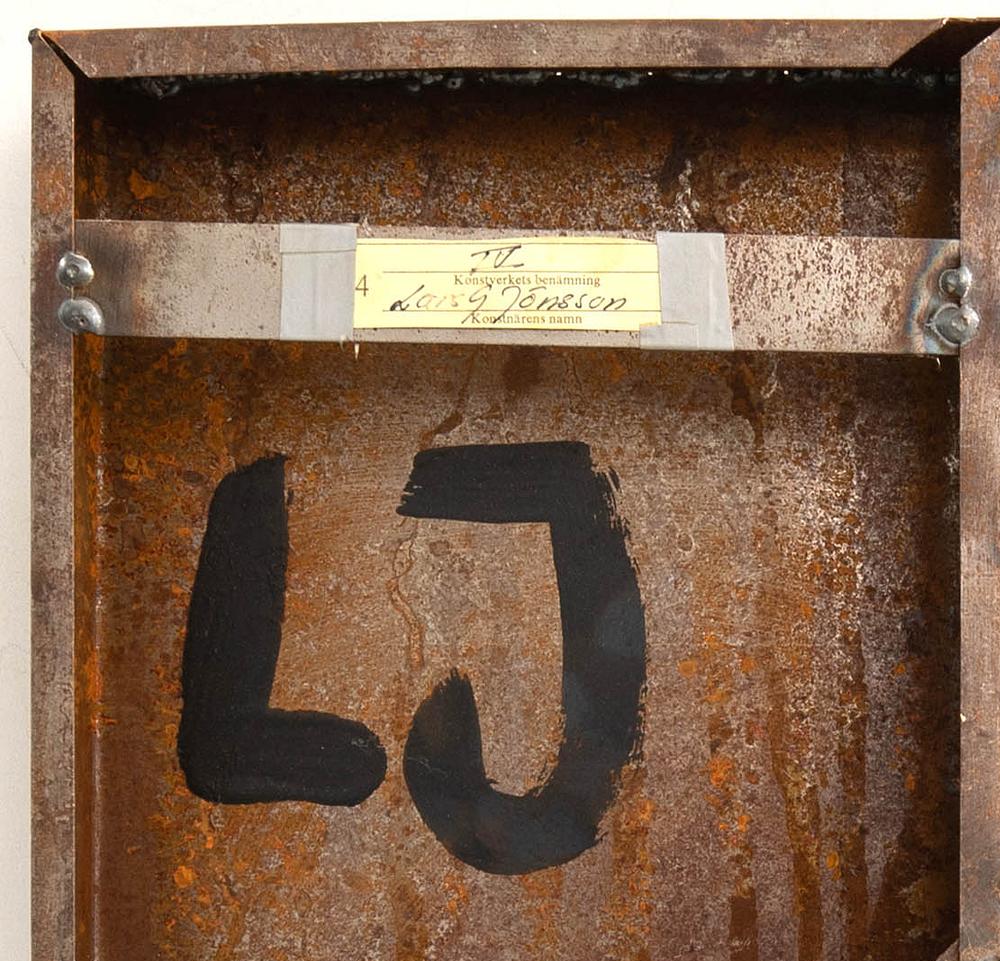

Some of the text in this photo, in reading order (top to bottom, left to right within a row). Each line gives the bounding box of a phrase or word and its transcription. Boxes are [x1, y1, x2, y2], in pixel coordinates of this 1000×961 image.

[354, 274, 370, 297] 4
[453, 273, 601, 288] Konstverkets benämning
[389, 284, 465, 312] Lars
[471, 312, 583, 325] Konstnärens namn
[177, 441, 647, 876] LJ
